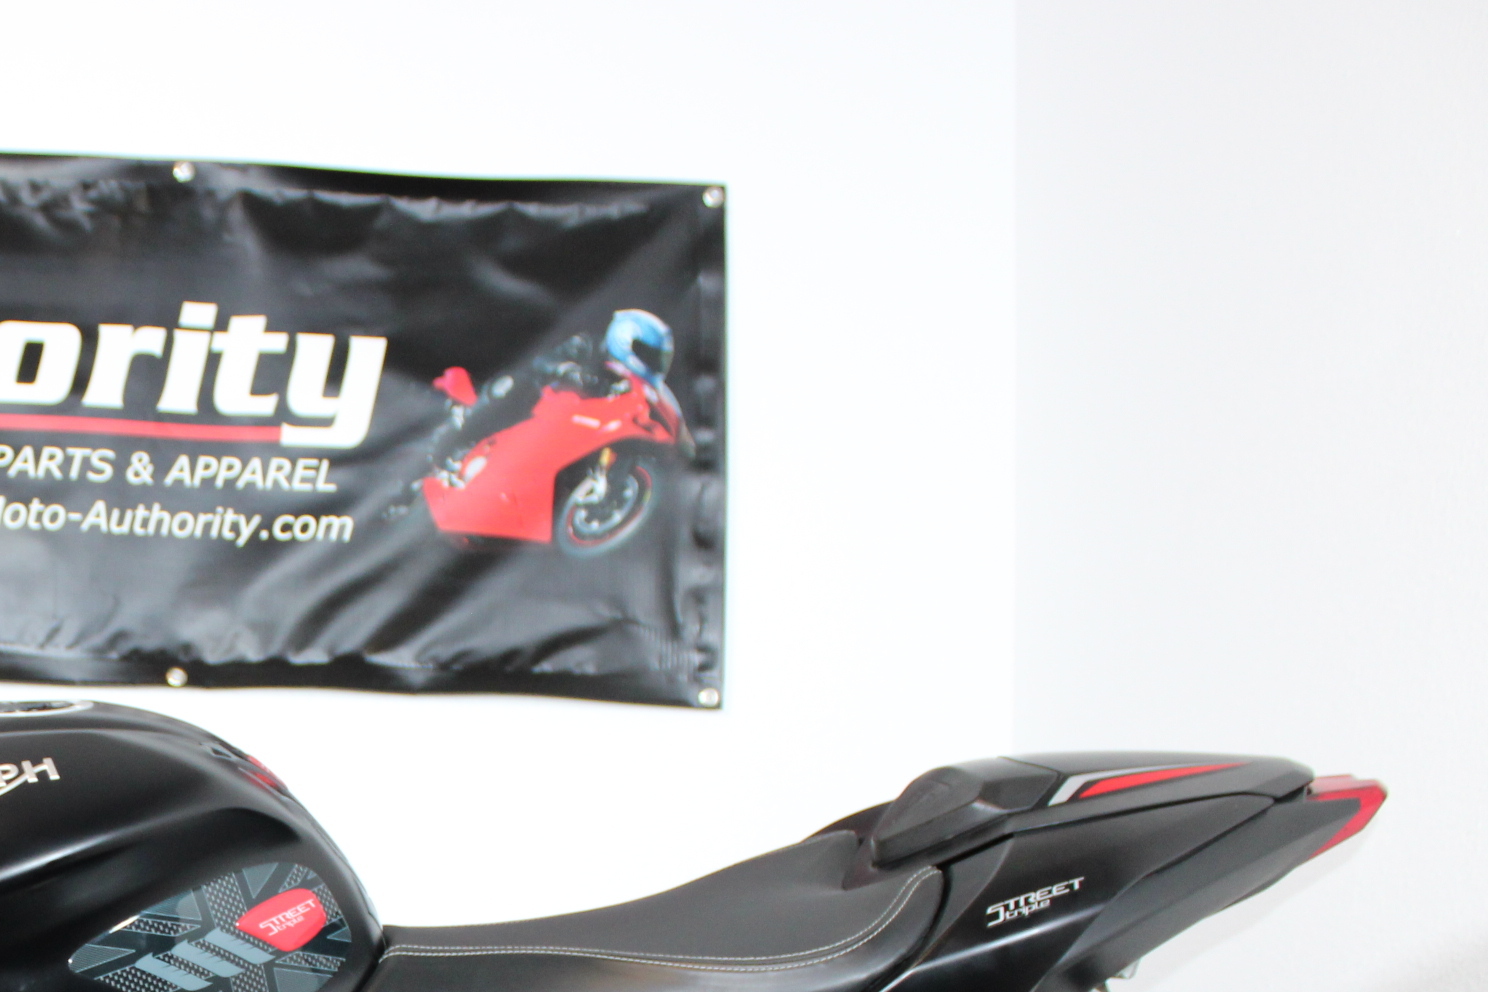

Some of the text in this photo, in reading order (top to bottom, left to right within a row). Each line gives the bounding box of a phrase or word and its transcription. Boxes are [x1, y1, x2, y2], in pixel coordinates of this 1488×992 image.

[125, 450, 154, 486] &
[164, 454, 338, 492] APPAREL
[259, 899, 316, 936] STREET
[986, 876, 1085, 927] STREET
[1006, 898, 1051, 917] triple
